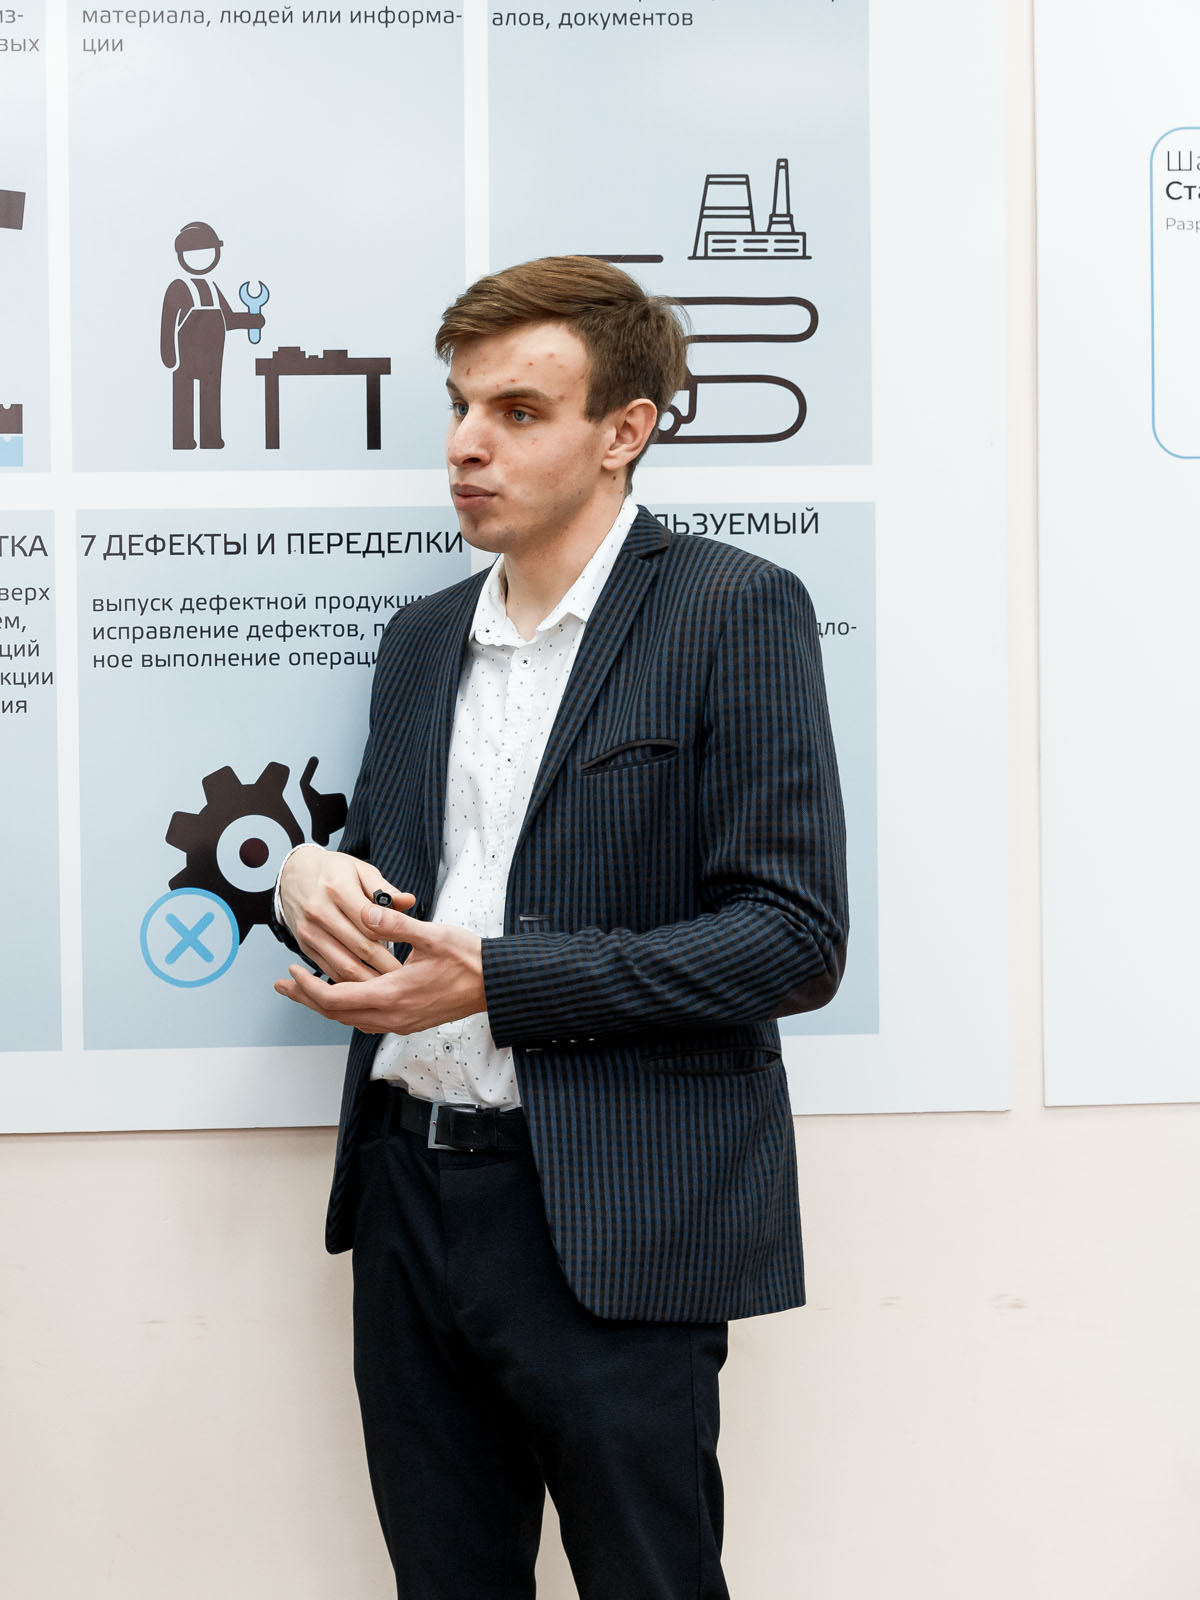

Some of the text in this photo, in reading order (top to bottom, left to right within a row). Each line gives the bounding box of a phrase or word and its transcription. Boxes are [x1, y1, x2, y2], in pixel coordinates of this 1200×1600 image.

[82, 5, 463, 29] материала, людей или информа-
[491, 11, 694, 31] алов, документов
[82, 38, 124, 56] ции
[1165, 181, 1200, 201] Ст
[80, 530, 463, 562] 7 ДЕФЕКТЫ И ПЕРЕДЕЛКИ
[92, 596, 174, 616] выпуск
[179, 592, 307, 616] дефектной
[92, 624, 240, 645] исправление
[245, 619, 366, 643] дефектов,
[92, 653, 134, 669] ное
[141, 651, 281, 668] выполнение
